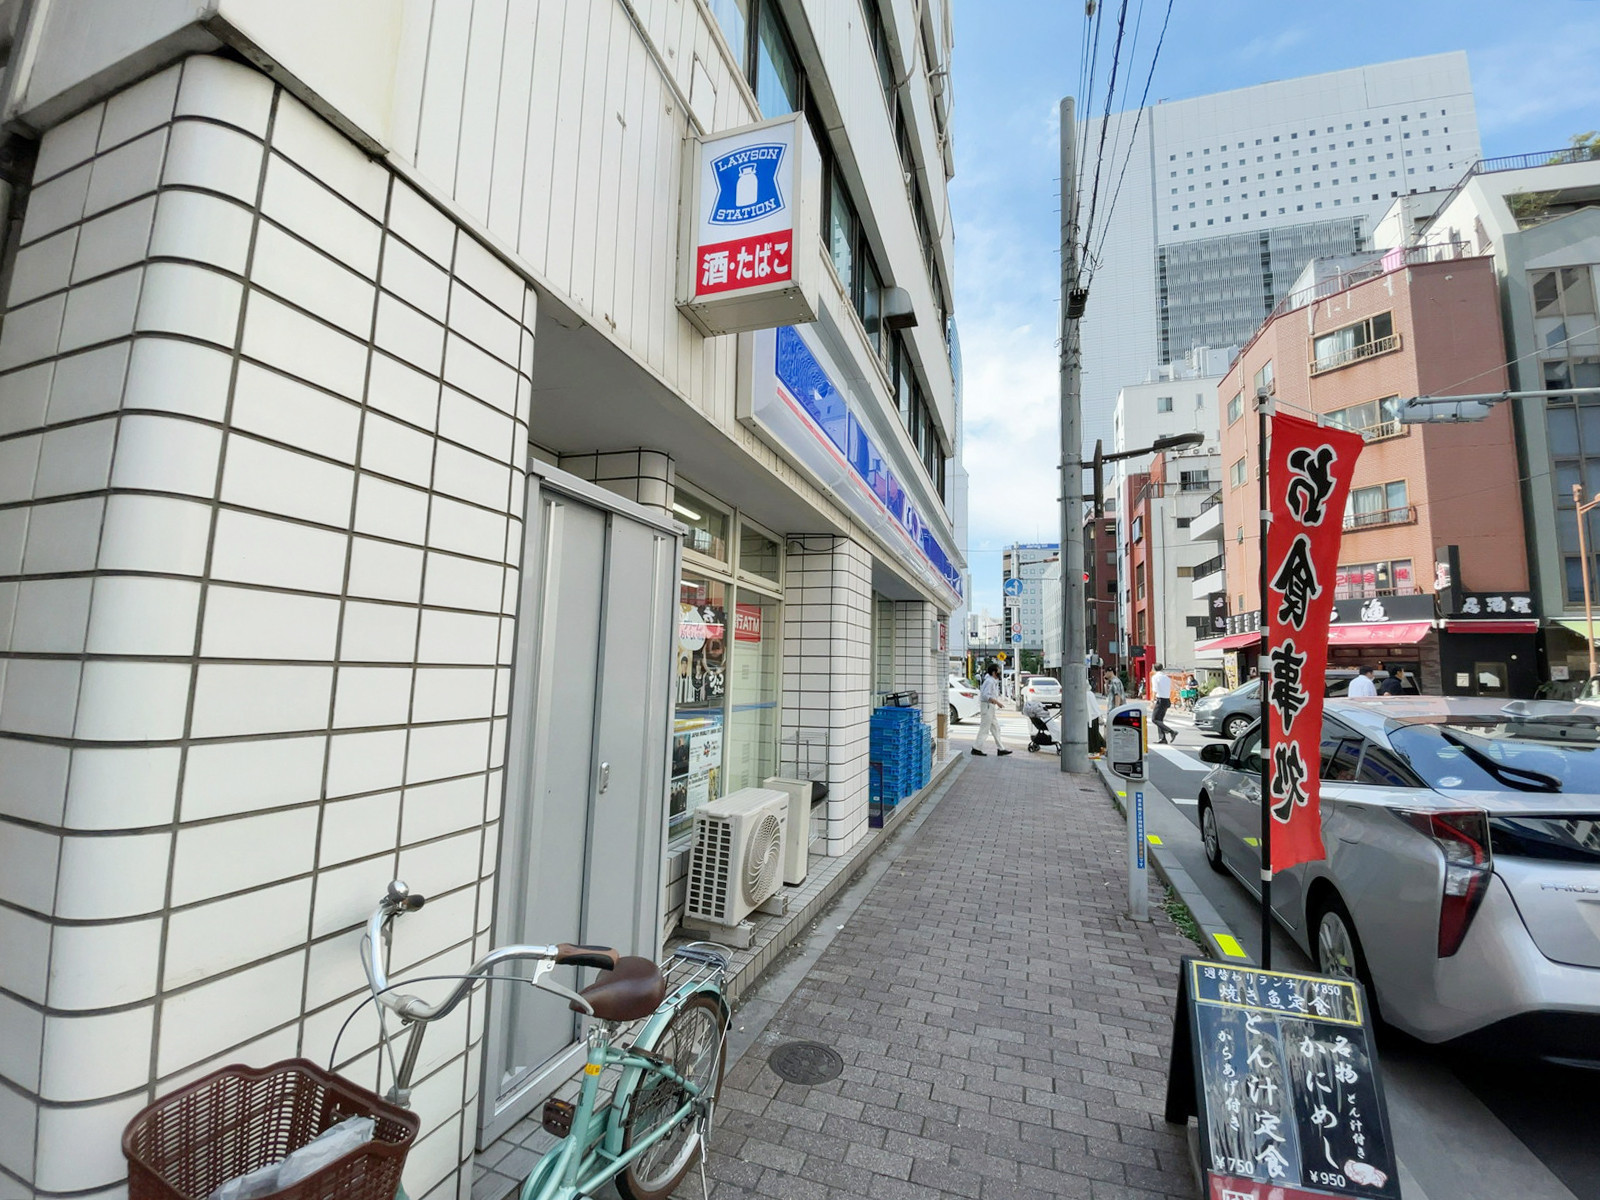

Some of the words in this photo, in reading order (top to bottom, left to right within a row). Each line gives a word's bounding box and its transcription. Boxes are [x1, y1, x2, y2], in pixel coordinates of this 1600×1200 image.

[717, 148, 779, 172] LAWSON
[716, 197, 777, 220] STATION
[1540, 883, 1599, 894] PRIUS
[1203, 967, 1297, 989] 週替わりランチ
[1312, 982, 1341, 997] ¥850
[1218, 984, 1331, 1016] 焼き魚定食
[1331, 1035, 1359, 1084] 名物
[1217, 1030, 1242, 1132] からあげ付き
[1243, 1012, 1290, 1179] とん汁定食
[1300, 1035, 1340, 1169] かにめし
[1346, 1093, 1366, 1159] とん汁付き
[1215, 1157, 1255, 1175] ¥750
[1309, 1170, 1347, 1188] ¥950
